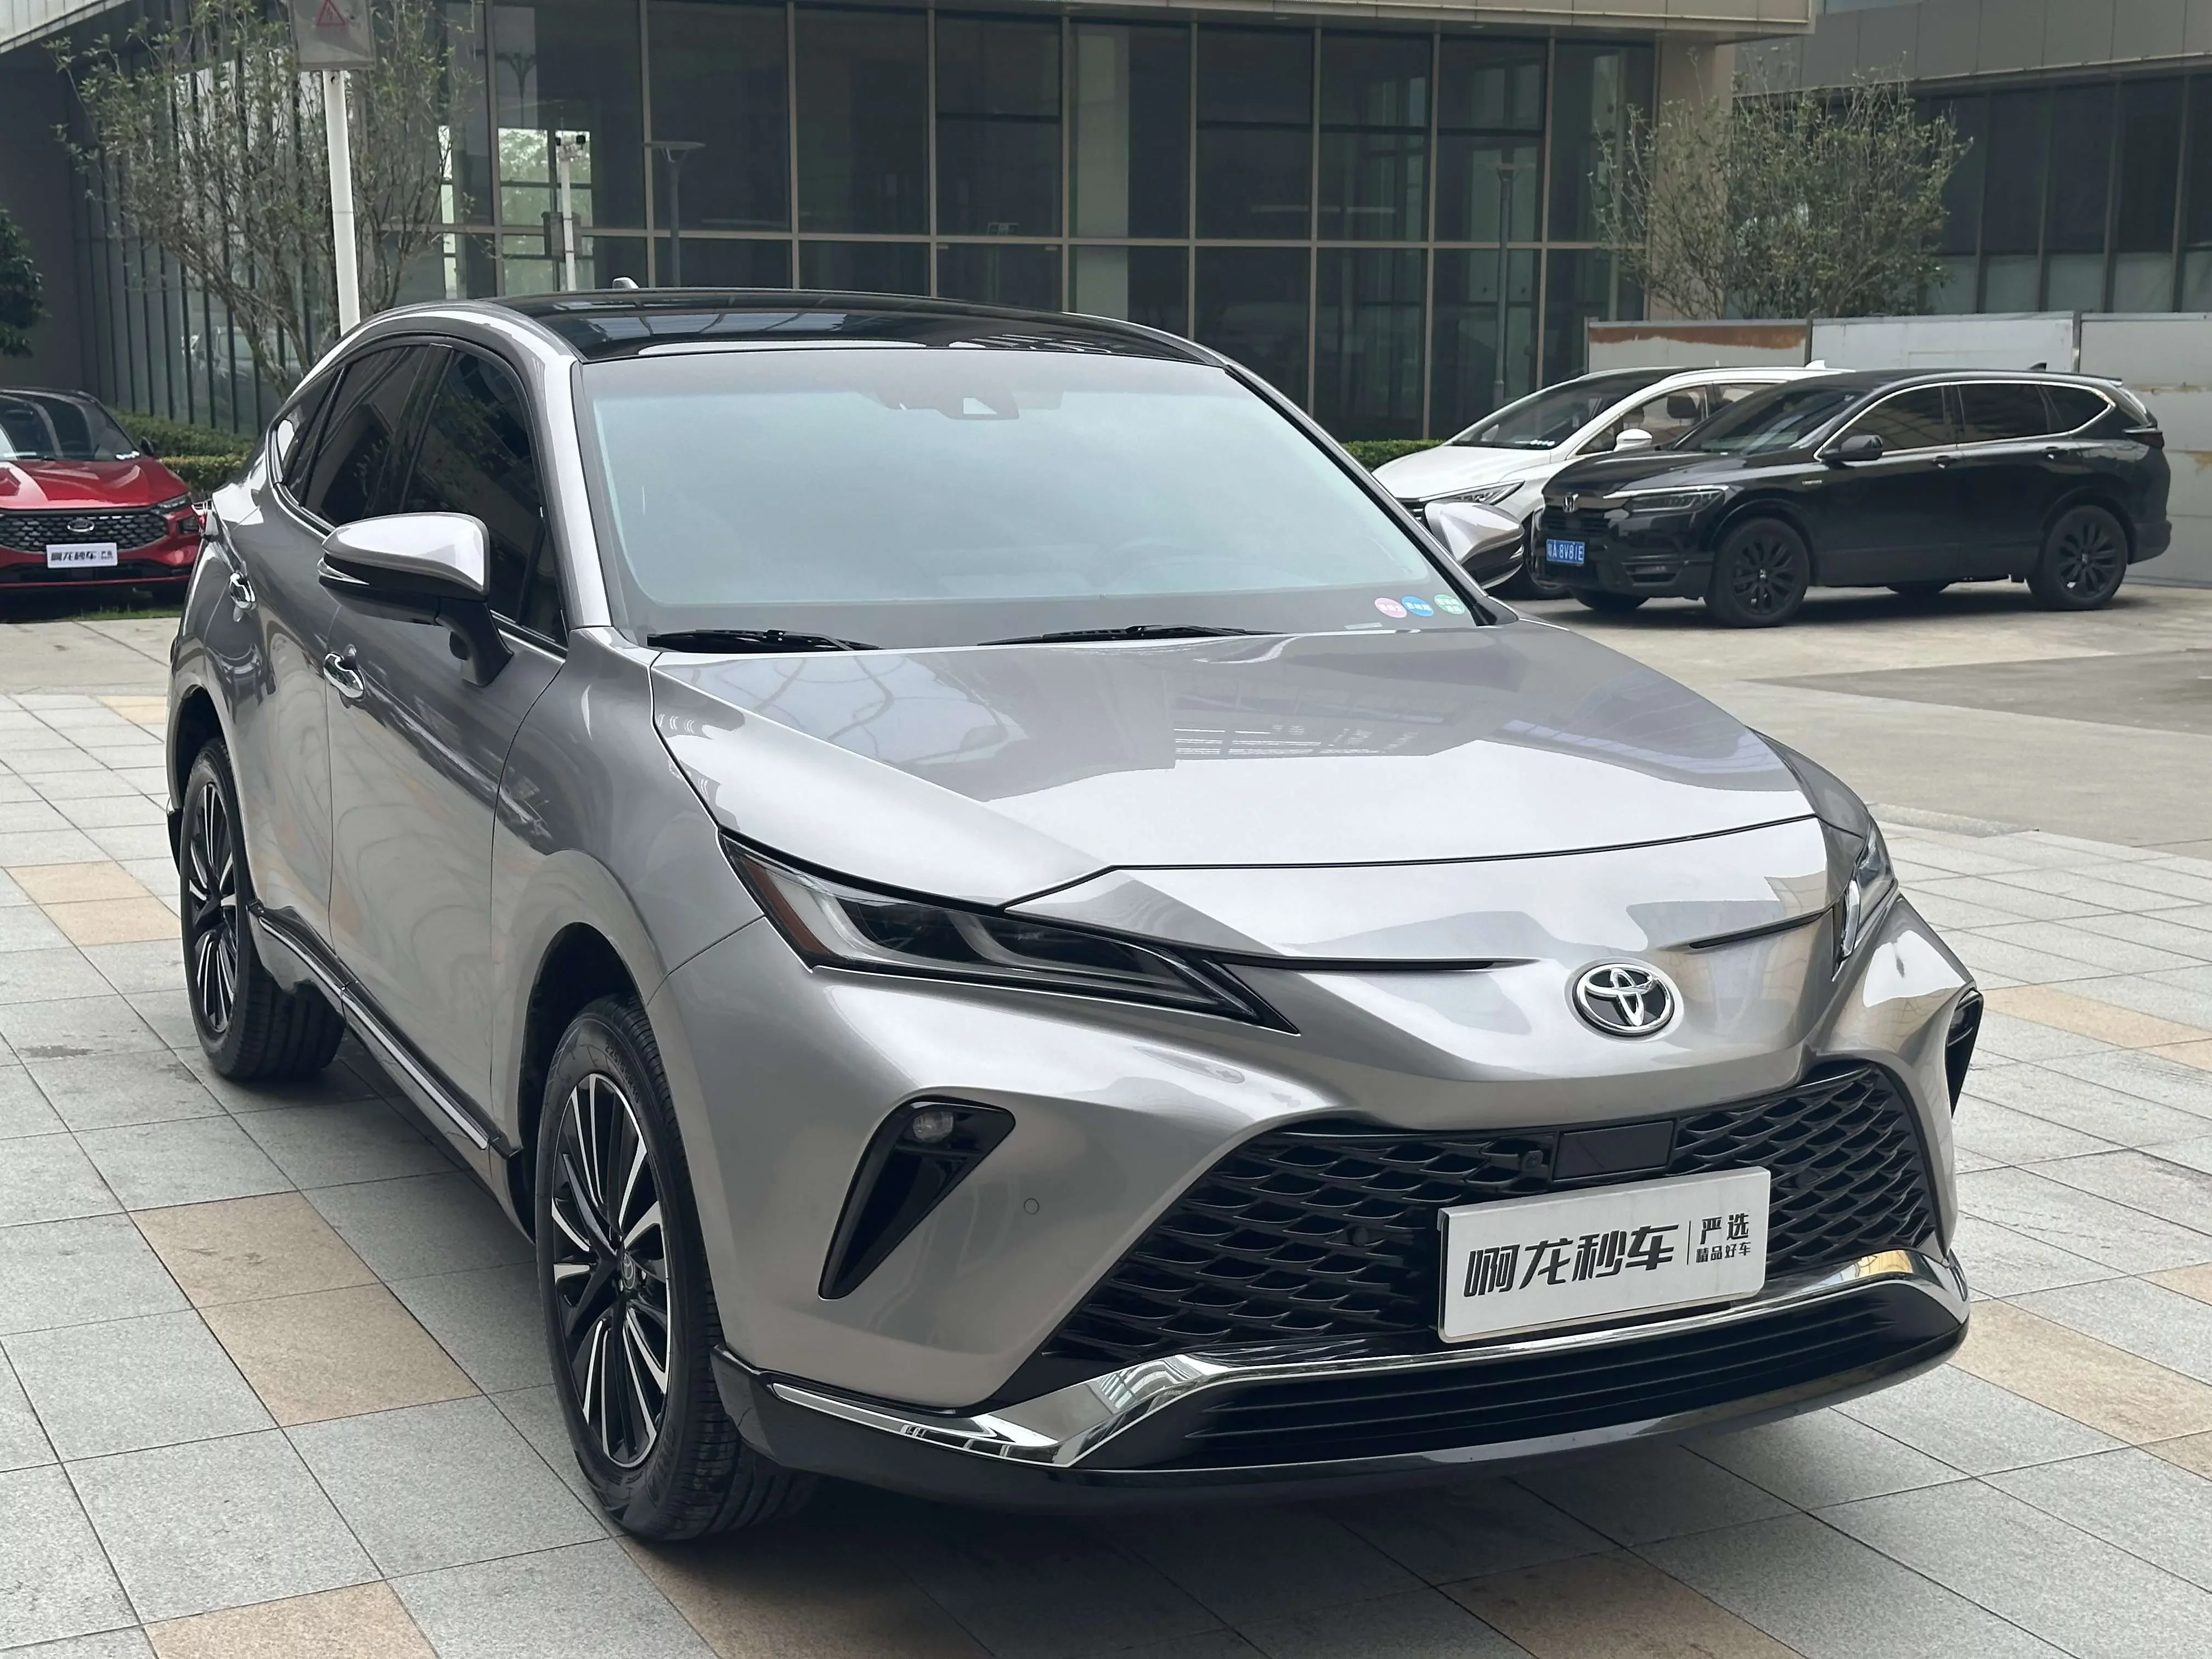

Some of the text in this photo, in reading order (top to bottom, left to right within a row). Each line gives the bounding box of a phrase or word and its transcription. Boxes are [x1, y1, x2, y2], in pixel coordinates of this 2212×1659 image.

[1700, 1212, 1749, 1245] 严选
[1463, 1224, 1679, 1297] 啊龙秒车
[1696, 1242, 1752, 1263] 精品好车
